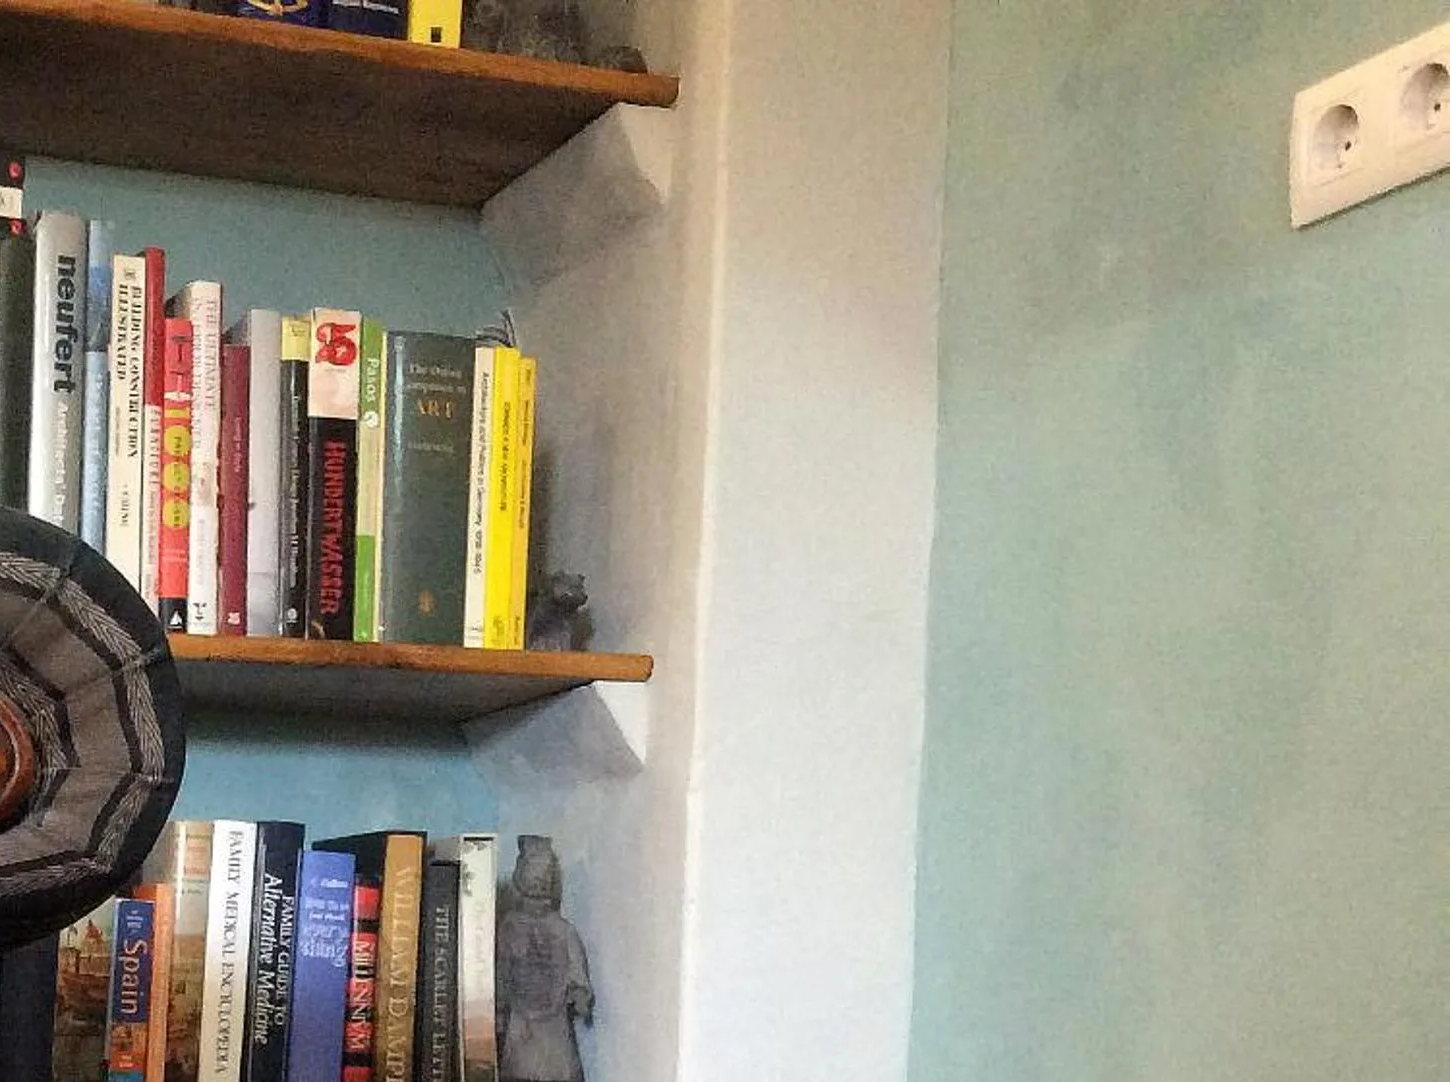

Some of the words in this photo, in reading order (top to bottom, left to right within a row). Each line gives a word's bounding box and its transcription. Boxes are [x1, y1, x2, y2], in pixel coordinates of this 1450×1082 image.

[52, 254, 79, 395] neufert
[319, 439, 347, 616] HUNDERTWASSER
[227, 830, 244, 883] FAMILY
[222, 892, 240, 958] MEDICAL
[260, 873, 283, 965] Alternative
[279, 896, 294, 947] FAMILY
[388, 866, 414, 987] WILLIAM
[436, 905, 450, 943] THE
[118, 939, 148, 1015] Spain
[254, 969, 276, 1045] Medicine
[276, 952, 291, 999] GUIDE
[431, 946, 448, 1025] SCARLET
[214, 962, 235, 1074] ENCYCLOPEDIA
[274, 1004, 288, 1025] TO
